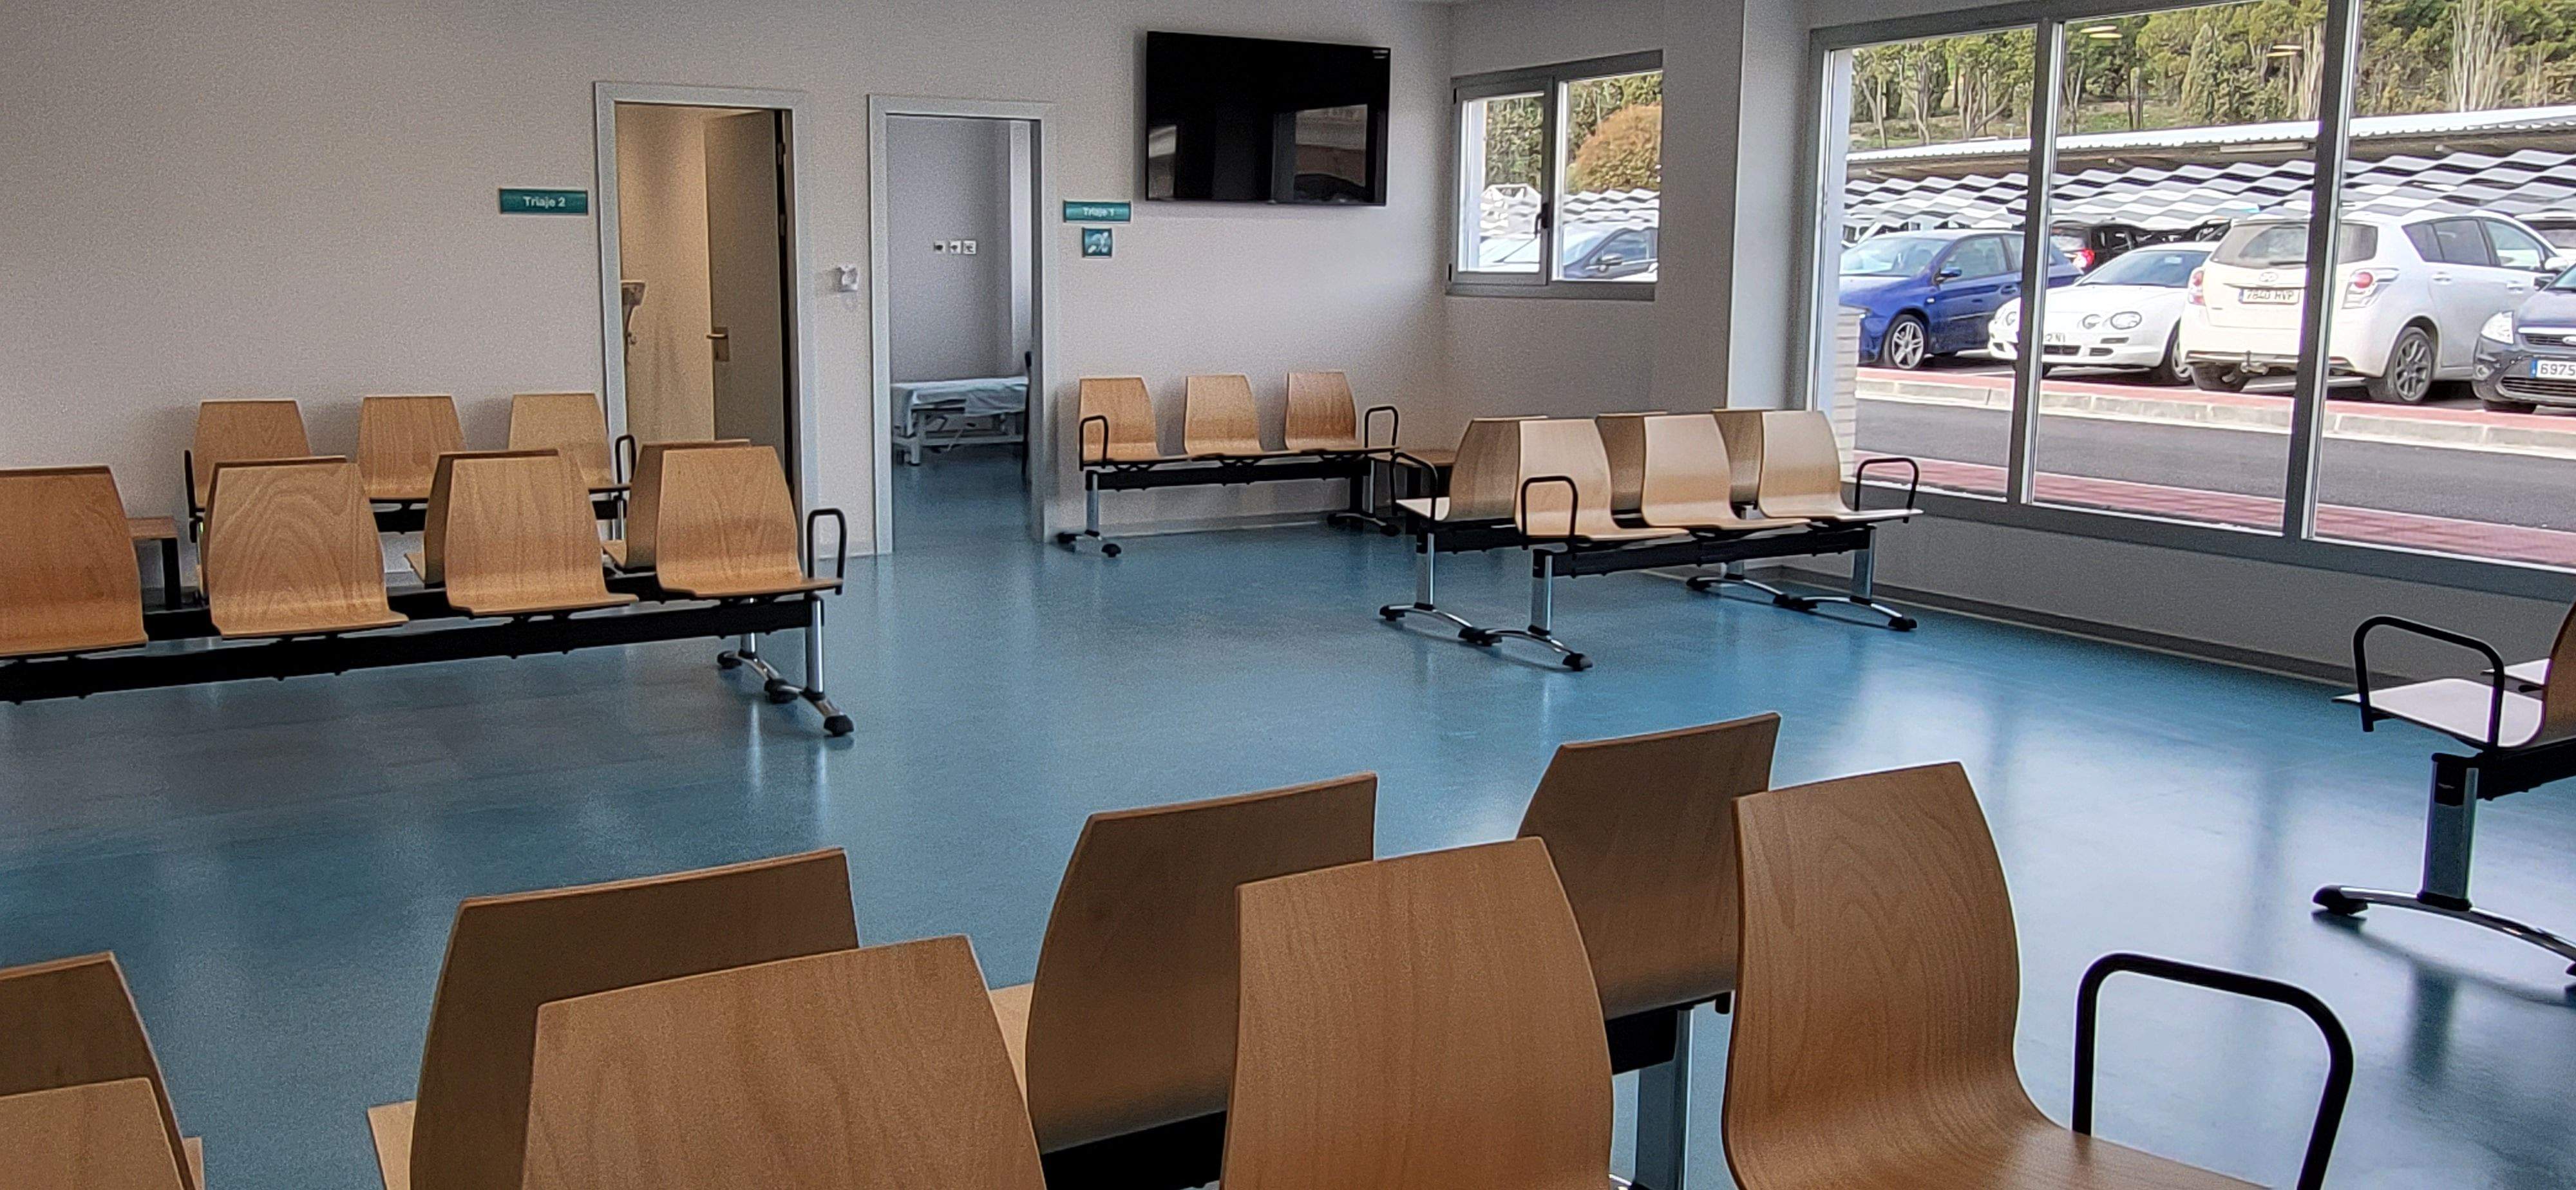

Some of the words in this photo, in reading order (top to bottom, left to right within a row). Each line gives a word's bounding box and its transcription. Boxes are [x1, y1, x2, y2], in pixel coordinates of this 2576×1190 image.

[523, 196, 556, 209] Triaje
[558, 196, 566, 207] 2
[2541, 363, 2576, 376] 6975
